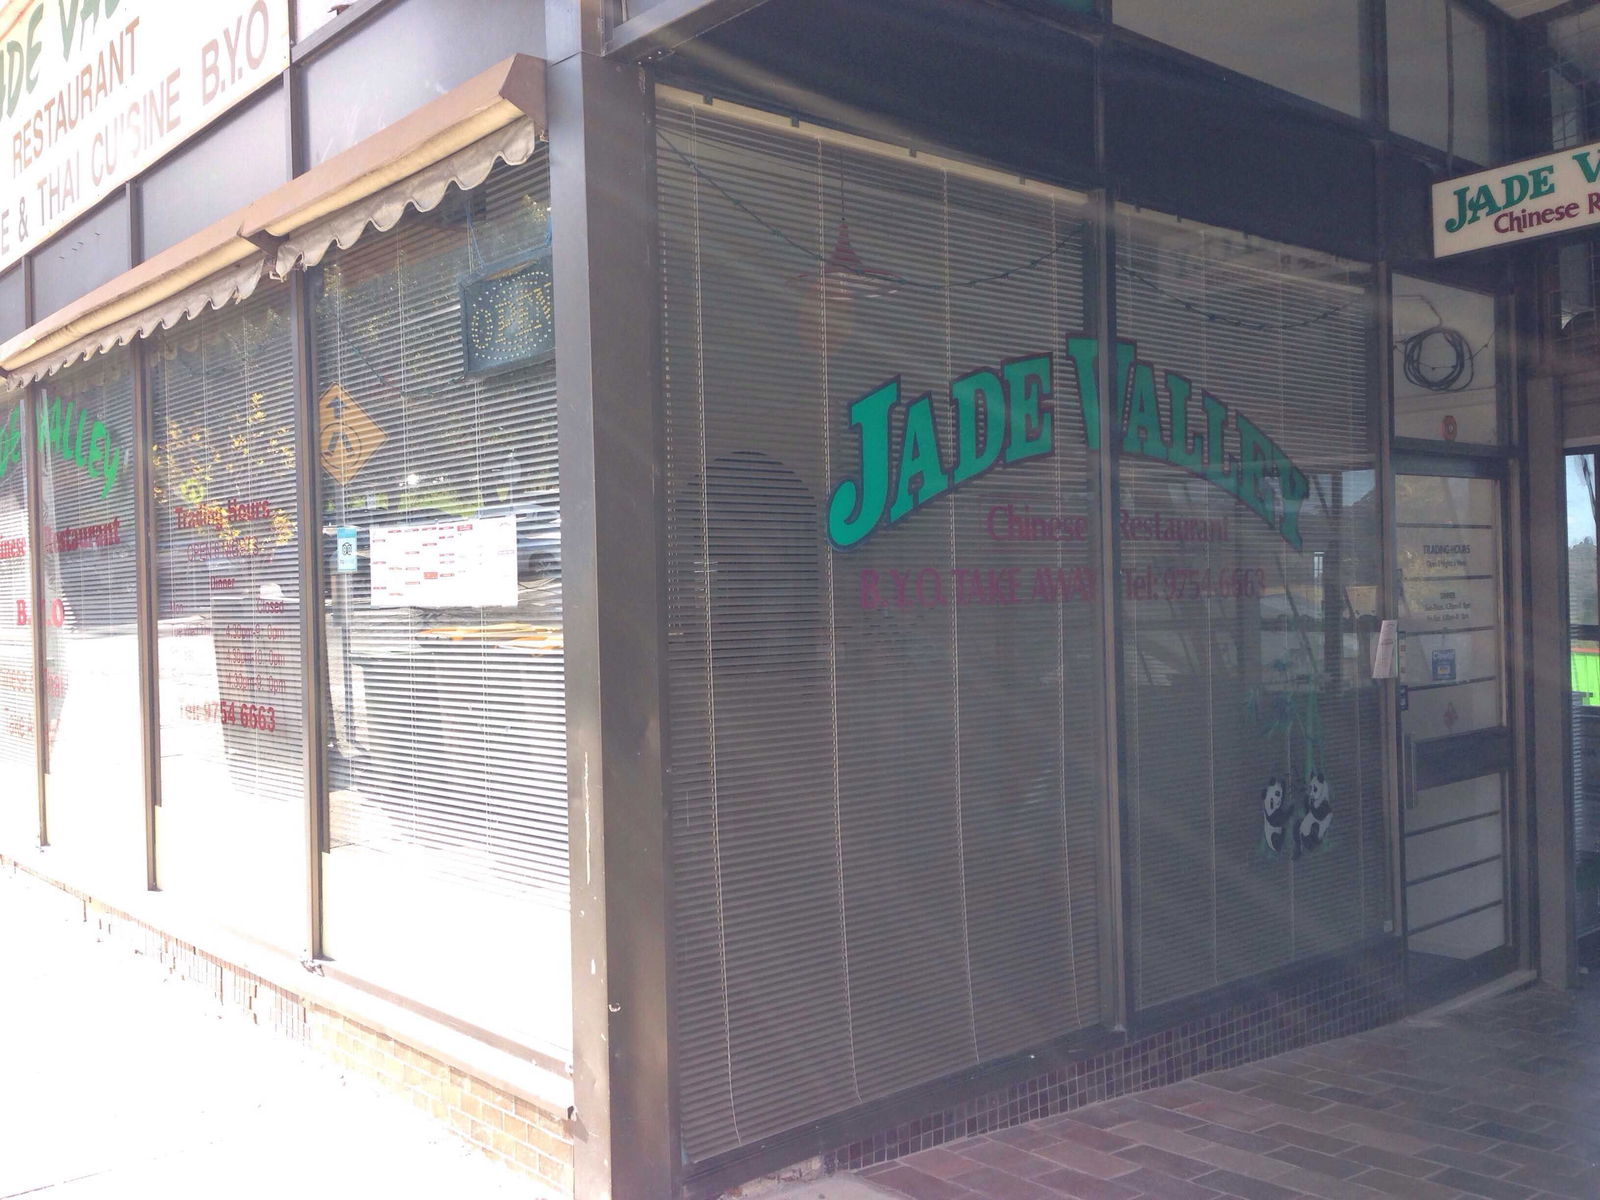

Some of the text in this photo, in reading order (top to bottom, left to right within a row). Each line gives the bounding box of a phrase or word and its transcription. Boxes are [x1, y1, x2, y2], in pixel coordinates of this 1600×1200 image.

[13, 16, 140, 180] RESTAURANT
[37, 149, 80, 226] THAI
[1445, 165, 1555, 232] JADE
[1494, 202, 1580, 234] Chinese
[827, 333, 1310, 552] JADE VALLEY
[174, 499, 270, 531] Trading Hours
[986, 504, 1230, 542] Chinese Restaurant
[209, 575, 236, 591] Dinner
[951, 566, 1020, 606] TAKE
[256, 597, 285, 614] Closed
[240, 703, 276, 733] 6663
